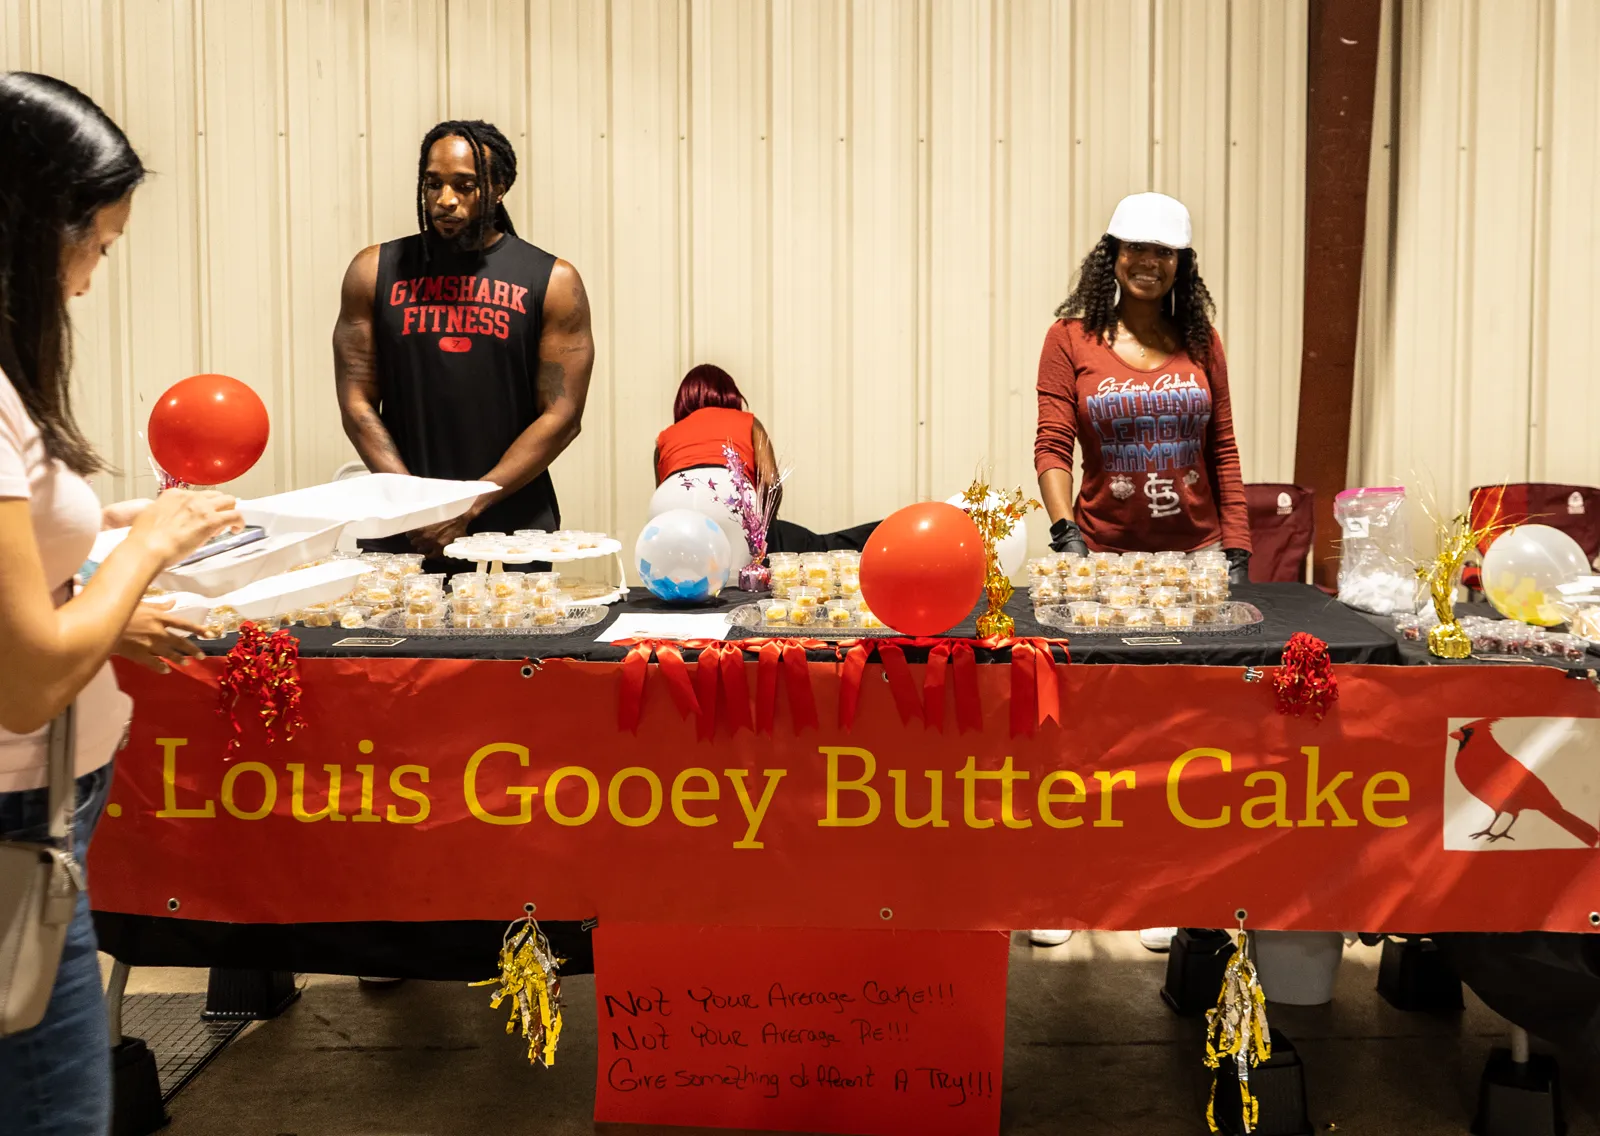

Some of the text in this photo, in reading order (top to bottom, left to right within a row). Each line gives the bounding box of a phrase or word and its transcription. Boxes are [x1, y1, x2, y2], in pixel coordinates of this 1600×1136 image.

[389, 275, 529, 314] GYMSHARK
[401, 305, 510, 340] FITNESS
[1086, 387, 1212, 420] NATIONAL
[155, 738, 1411, 850] Louis Gooey Butter Cake
[605, 986, 672, 1018] Not
[612, 1022, 672, 1051] Not
[895, 1069, 909, 1092] A
